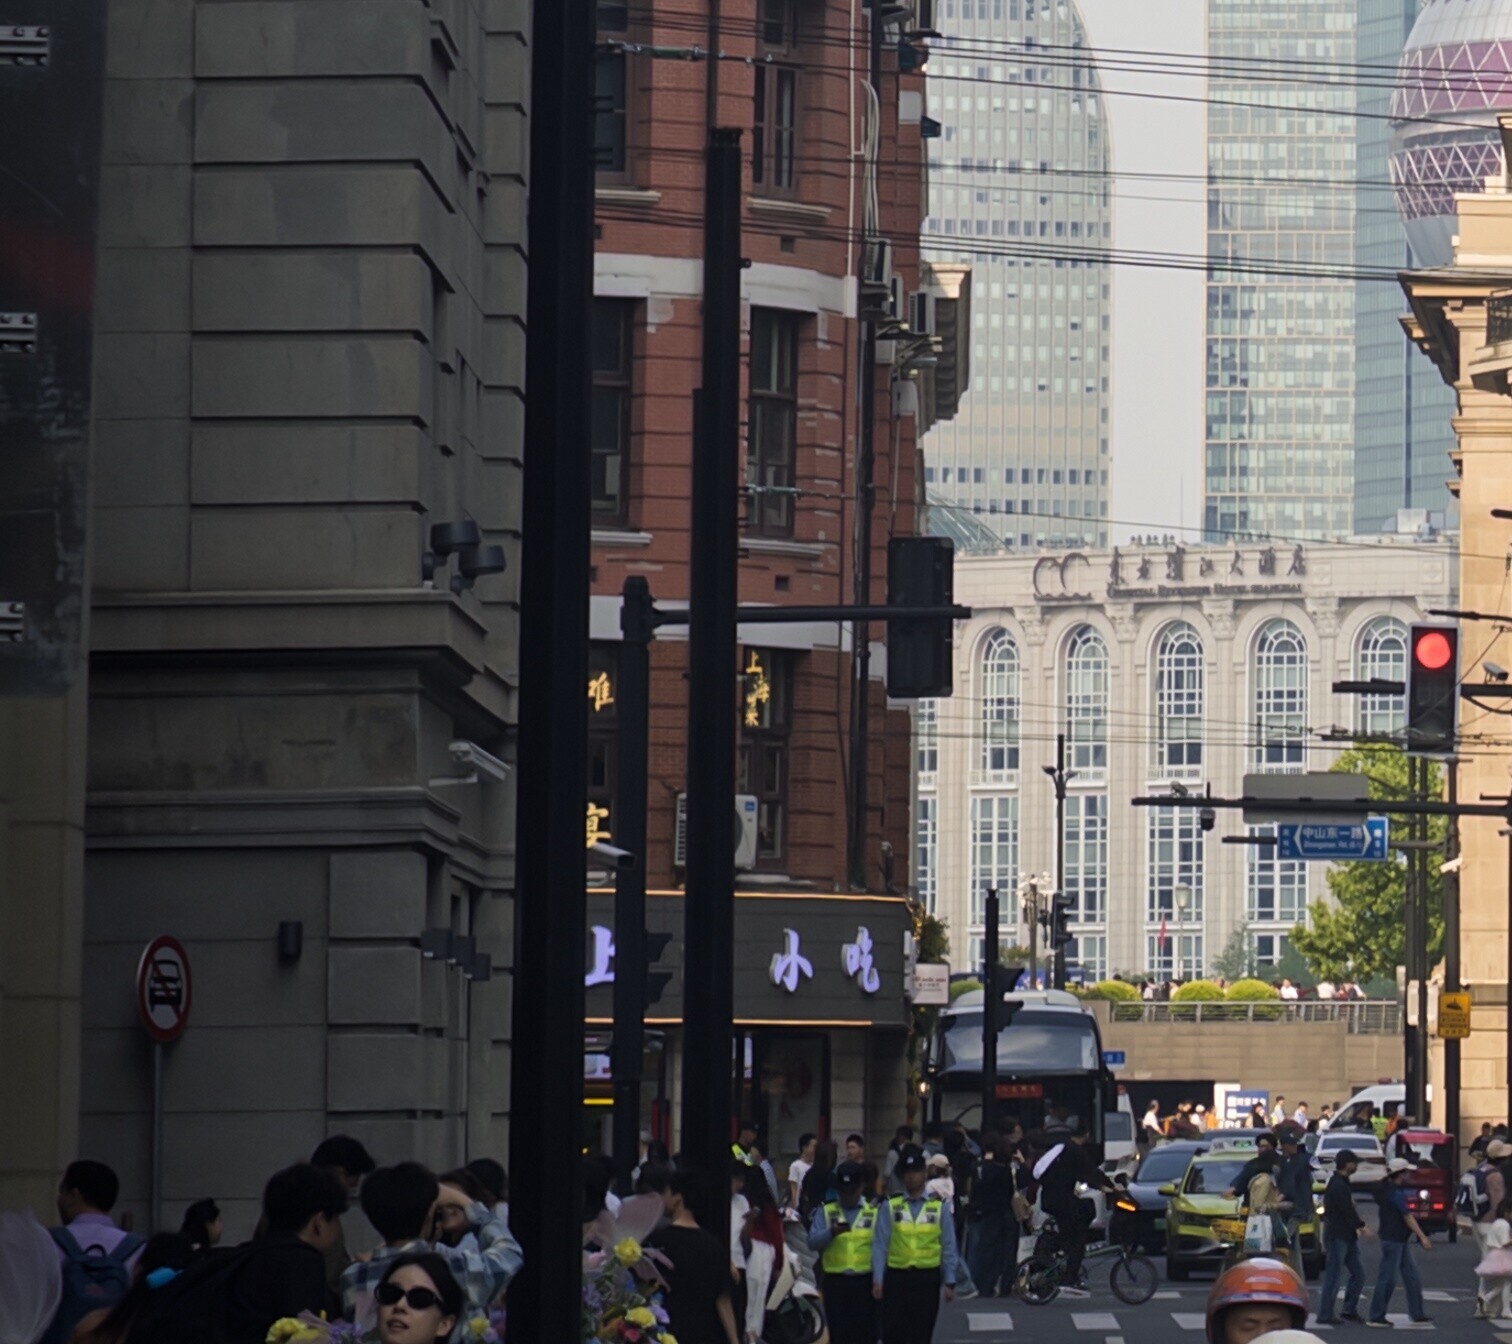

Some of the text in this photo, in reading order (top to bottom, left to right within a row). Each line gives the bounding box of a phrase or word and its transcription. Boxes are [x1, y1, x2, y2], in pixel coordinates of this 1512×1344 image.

[1302, 826, 1363, 840] 中山东一路
[769, 926, 880, 993] 小吃
